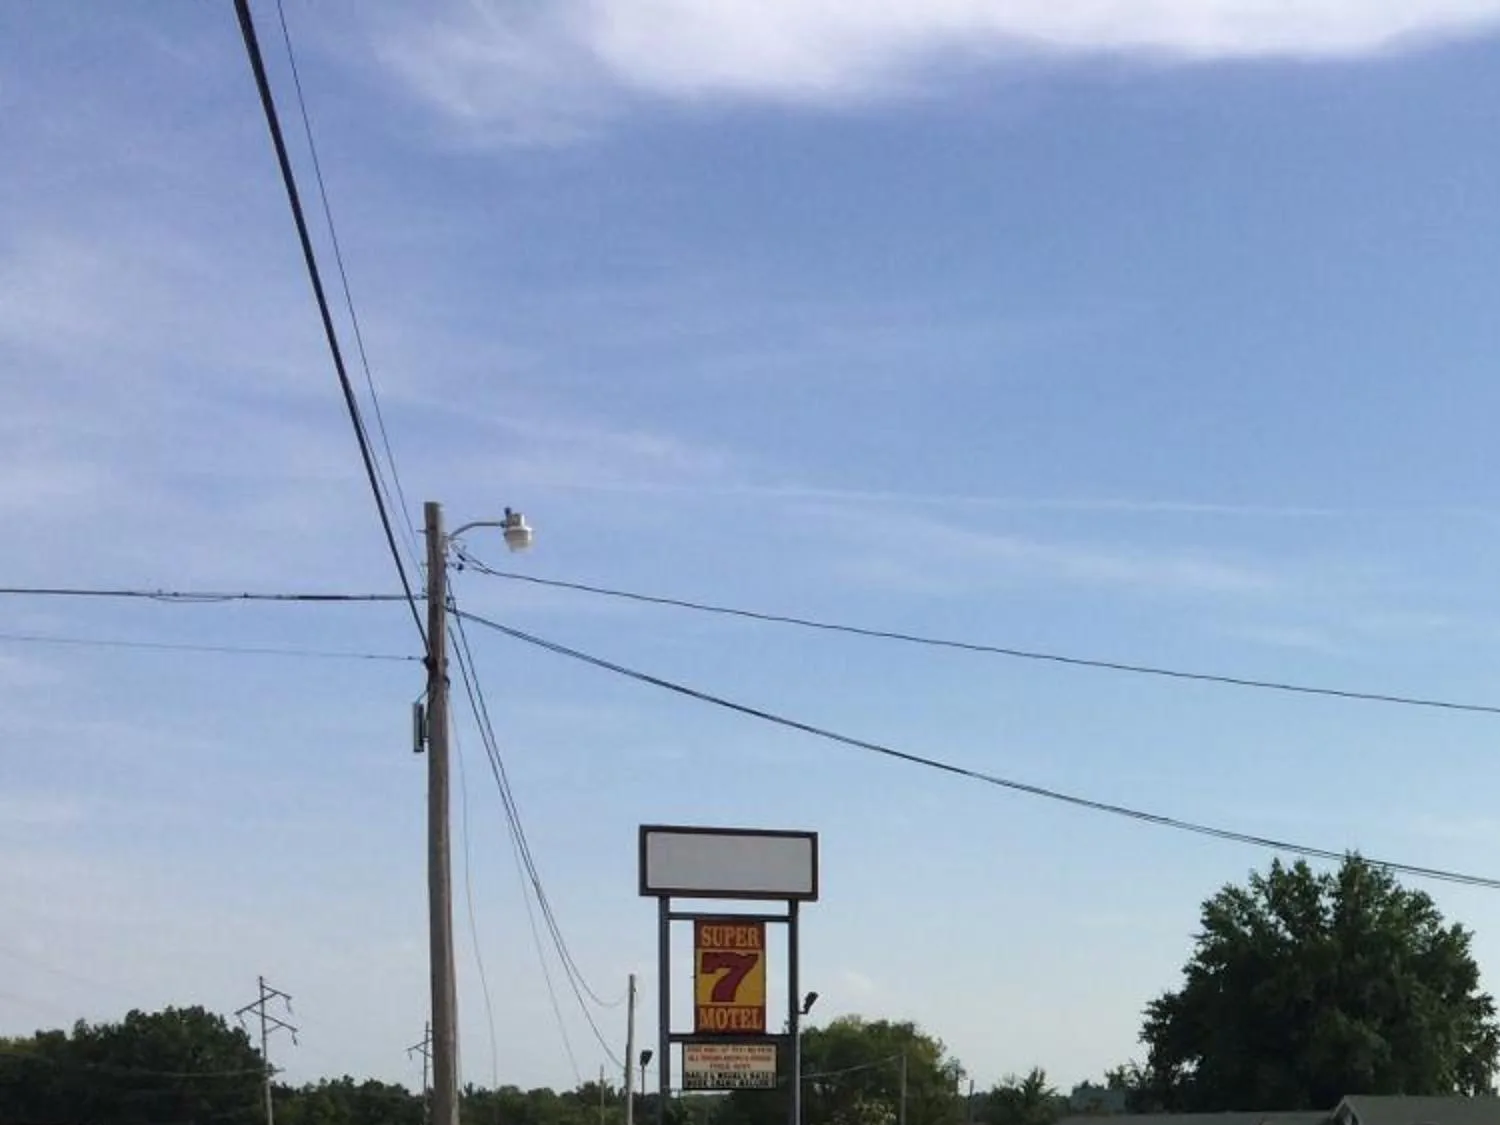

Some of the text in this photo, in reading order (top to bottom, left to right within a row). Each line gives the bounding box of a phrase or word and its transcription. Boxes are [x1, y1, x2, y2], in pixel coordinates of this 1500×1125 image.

[702, 926, 760, 947] SUPER
[701, 952, 758, 1003] 7
[700, 1007, 762, 1030] MOTEL
